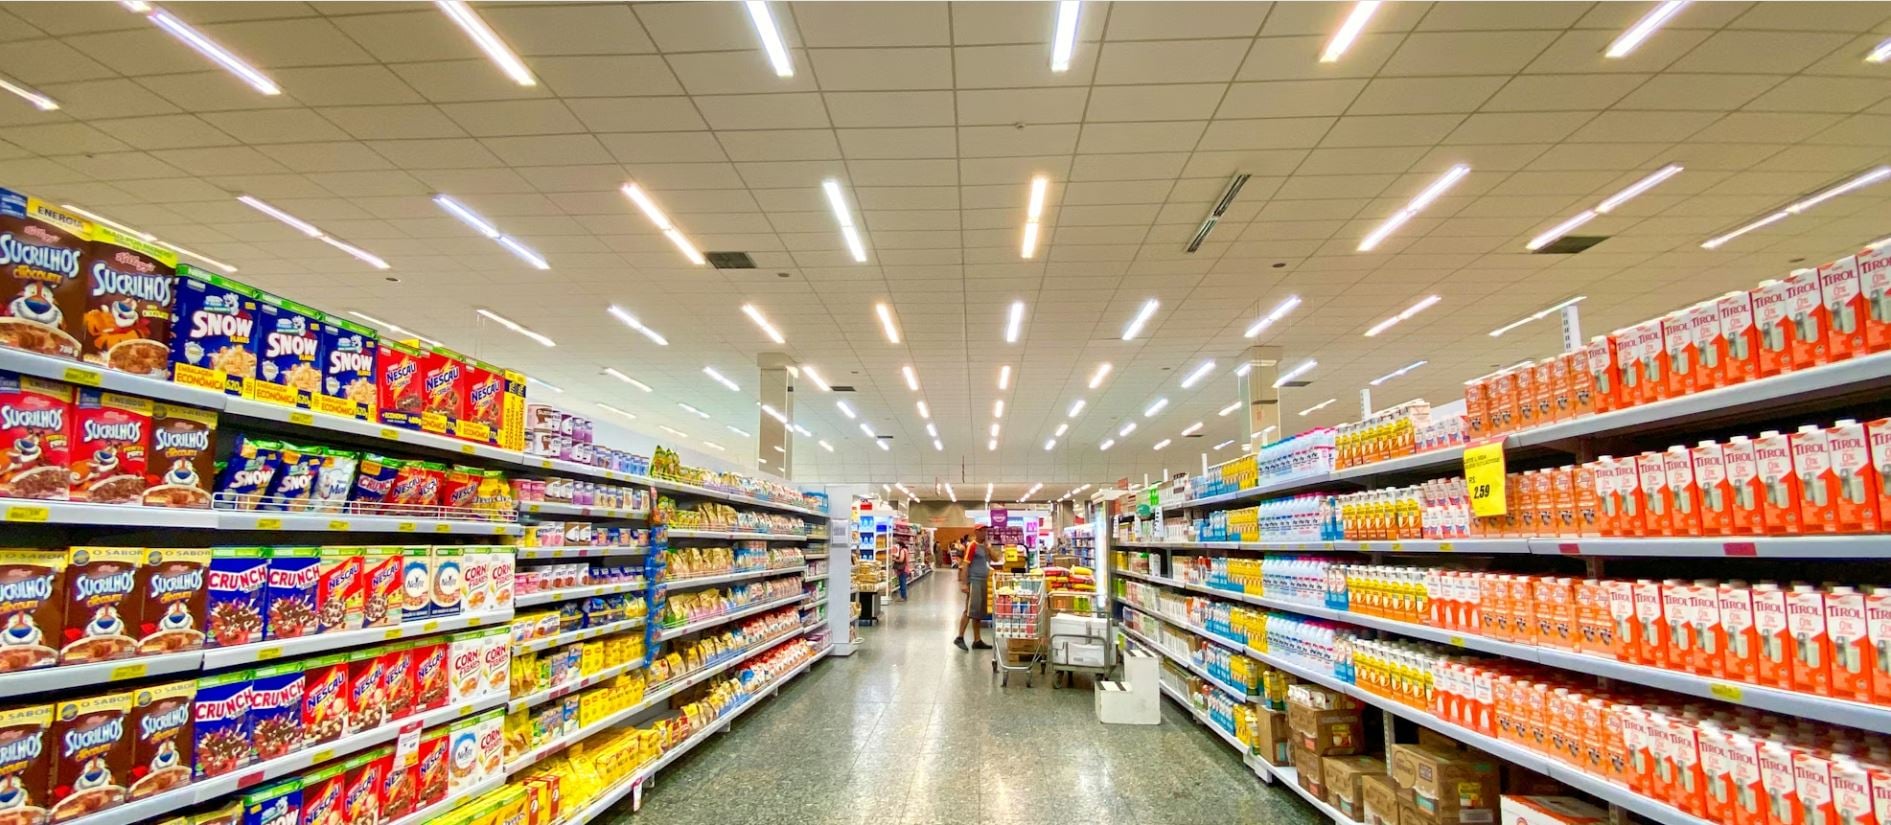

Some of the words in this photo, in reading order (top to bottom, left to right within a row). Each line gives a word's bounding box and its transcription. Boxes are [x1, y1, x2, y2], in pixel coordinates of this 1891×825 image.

[0, 233, 80, 279] SUCRILHOS
[1860, 256, 1891, 274] TIRO
[93, 262, 171, 307] SUCRILHOS
[1822, 270, 1857, 287] TIROL
[1785, 281, 1819, 299] TIROL
[1754, 291, 1786, 310] TIROL
[1691, 312, 1719, 329] TIROL
[1721, 302, 1750, 320] TIROL
[190, 311, 253, 339] SNOW
[1665, 321, 1690, 336] TIROL
[267, 331, 318, 357] SNOW
[1617, 339, 1637, 351] TIROL
[1638, 331, 1661, 345] TIROL
[329, 350, 373, 374] SNOW
[386, 361, 417, 384] NESCAU
[426, 366, 459, 392] NESCAU
[470, 380, 500, 403] NESCAU
[1, 405, 63, 431] SUCRILHOS
[84, 420, 141, 443] SUCRILHOS
[156, 428, 209, 451] SUCRILHOS
[1756, 448, 1788, 460] TIROL
[1793, 443, 1827, 456] TIROL
[1829, 438, 1865, 451] TIROL
[1665, 457, 1689, 472] TIROL
[1694, 456, 1723, 468] TIROL
[1725, 452, 1754, 464] TIROL
[229, 467, 275, 489] SNOW
[1639, 462, 1663, 475] TIROL
[358, 474, 393, 493] CRUNC
[208, 566, 267, 591] CRUNCH
[269, 565, 320, 589] CRUNCH
[328, 562, 361, 590] NESCAU
[372, 562, 399, 587] NESCAU
[465, 564, 487, 582] CORN
[492, 562, 512, 581] CORN
[76, 570, 135, 601] SUCRILHOS
[151, 569, 203, 598] SUCRILHOS
[1636, 592, 1657, 604] TIROL
[1663, 594, 1688, 607] TIROL
[1689, 597, 1717, 608] TIROL
[1720, 599, 1750, 611] TIROL
[1755, 600, 1785, 613] TIROL
[1788, 602, 1822, 616] TIROL
[1827, 605, 1865, 620] TIROL
[417, 649, 445, 679] NESCAU
[454, 649, 479, 671] CORN
[485, 644, 506, 665] CORN
[385, 653, 410, 685] NESCAU
[306, 671, 345, 710] NESCAU
[352, 663, 384, 699] NESCAU
[196, 687, 253, 720] CRUNCH
[252, 679, 305, 708] CRUNCH
[141, 703, 190, 741] SUCRILHOS
[64, 716, 125, 758] SUCRILHOS
[480, 727, 500, 749] CORN
[1670, 732, 1694, 748] TIROL
[420, 740, 448, 774] NESCAU
[1700, 741, 1727, 758] TIROL
[1728, 749, 1757, 766] TIROL
[1760, 757, 1793, 776] TIROL
[1795, 766, 1829, 786] TIROL
[345, 766, 377, 809] NESCAU
[1832, 776, 1868, 796] TIROL
[304, 781, 342, 825] NESCAU
